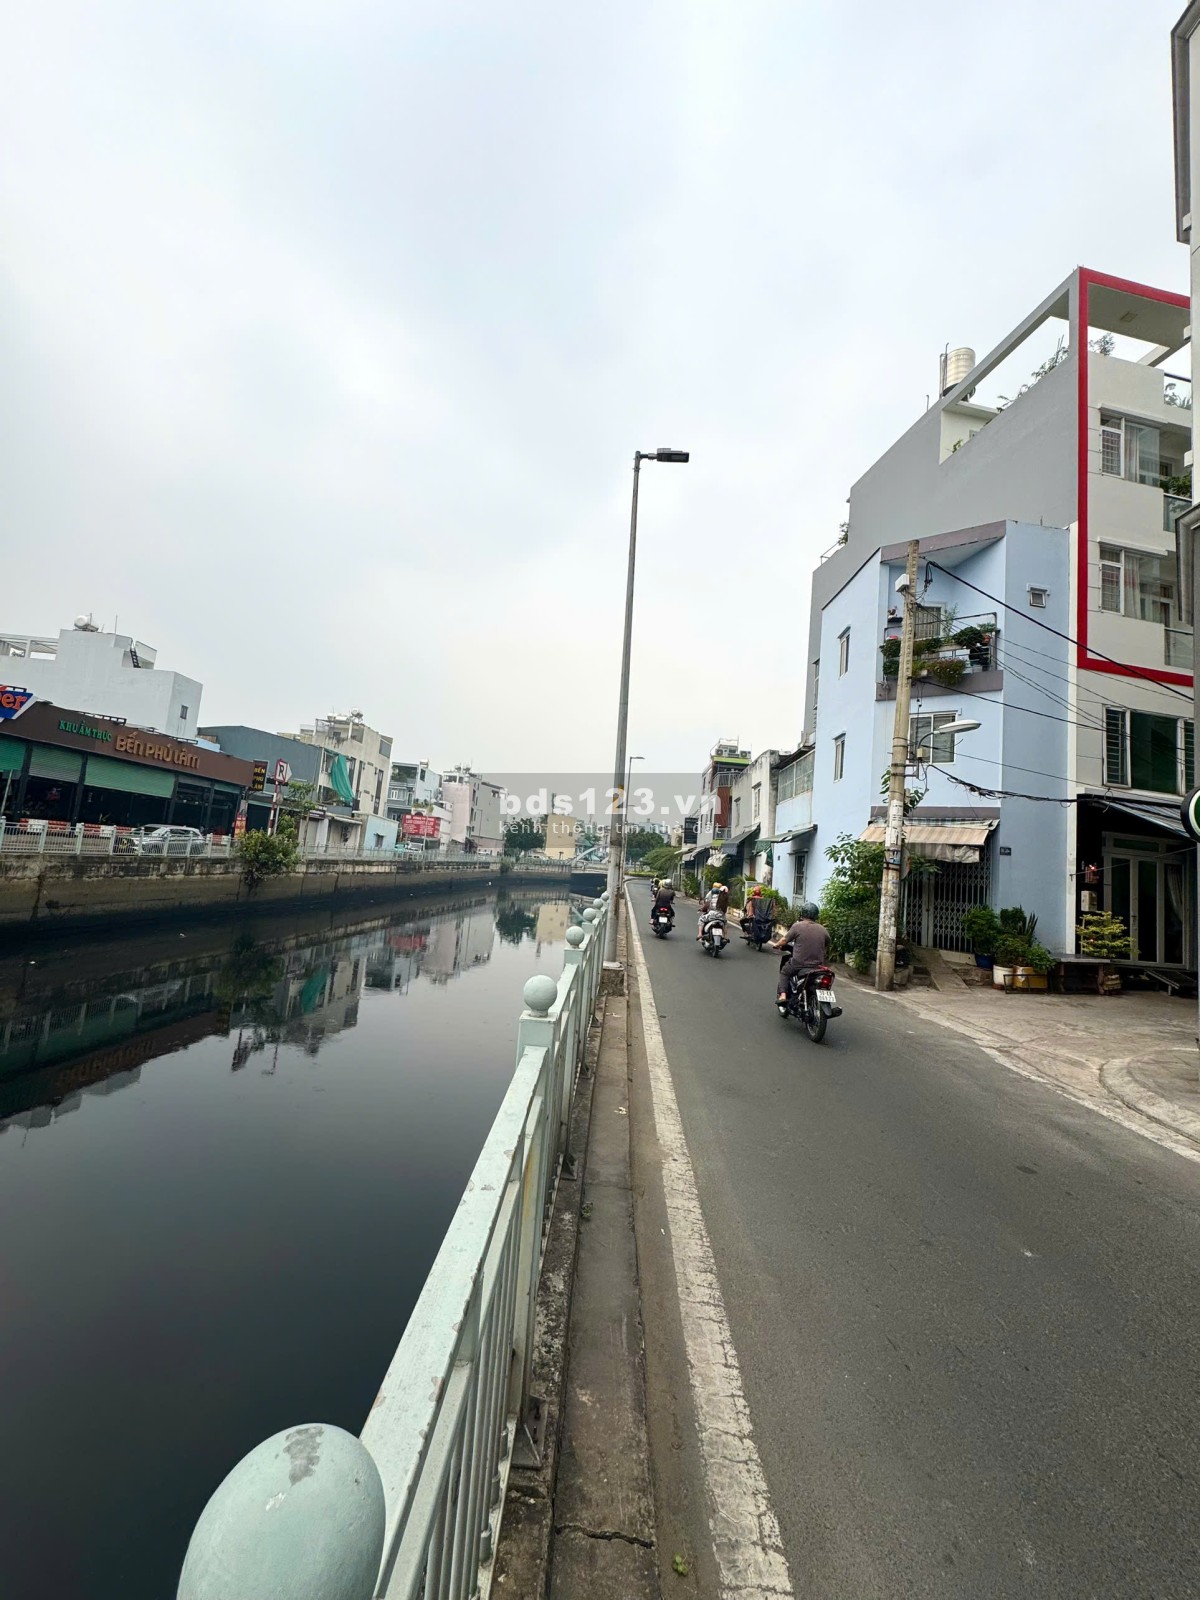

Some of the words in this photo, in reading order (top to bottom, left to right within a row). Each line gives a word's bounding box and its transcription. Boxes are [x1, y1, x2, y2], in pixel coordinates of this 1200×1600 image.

[0, 693, 27, 710] er
[59, 720, 78, 732] KHU
[92, 728, 113, 743] THỰC
[115, 731, 144, 756] BẾN
[145, 743, 172, 762] PHÚ
[174, 748, 200, 769] LÂM
